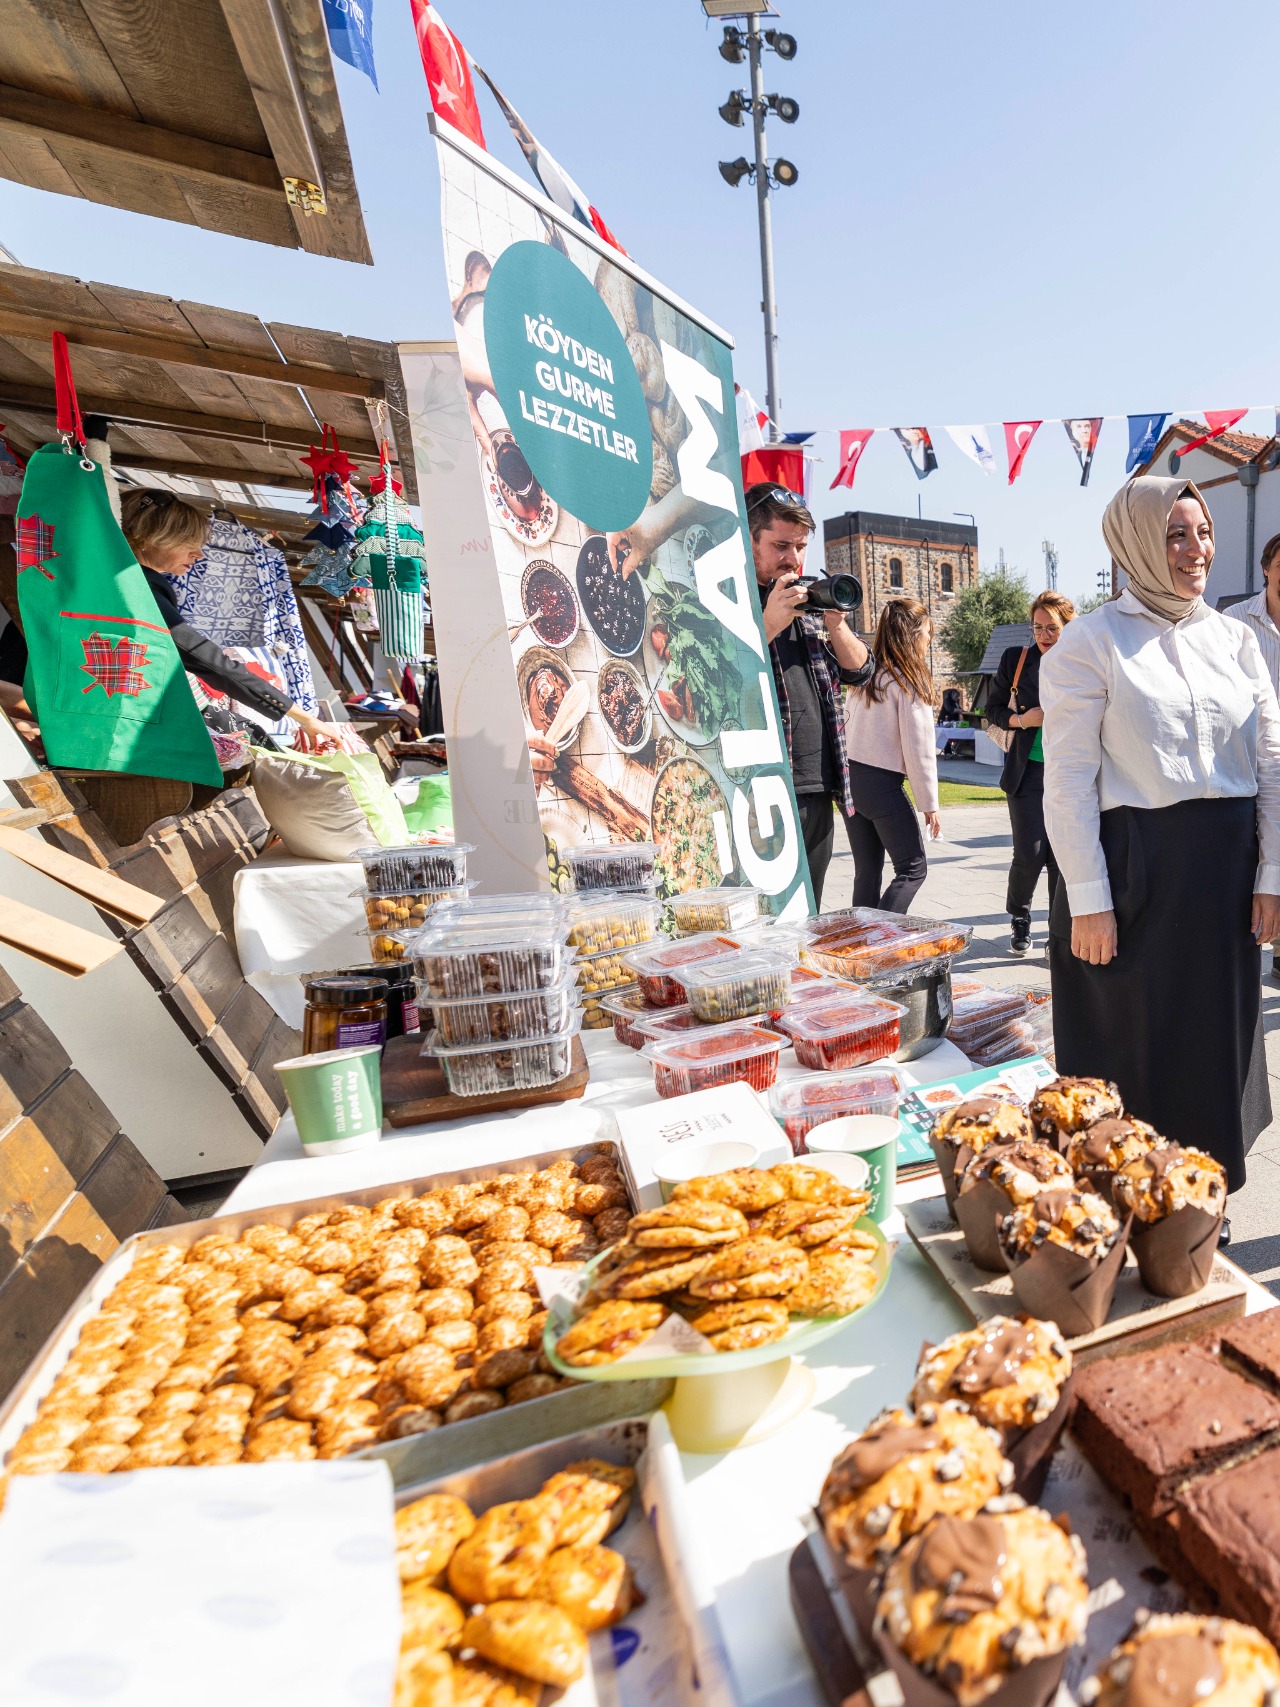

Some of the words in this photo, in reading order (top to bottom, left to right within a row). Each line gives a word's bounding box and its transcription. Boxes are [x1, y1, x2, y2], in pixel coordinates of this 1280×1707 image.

[523, 313, 615, 385] KÖYDEN
[535, 360, 617, 420] GURME
[518, 389, 640, 465] LEZZETLER
[331, 1074, 344, 1104] today
[347, 1070, 359, 1092] day
[333, 1104, 346, 1133] make
[347, 1093, 363, 1120] good
[352, 1121, 362, 1130] a
